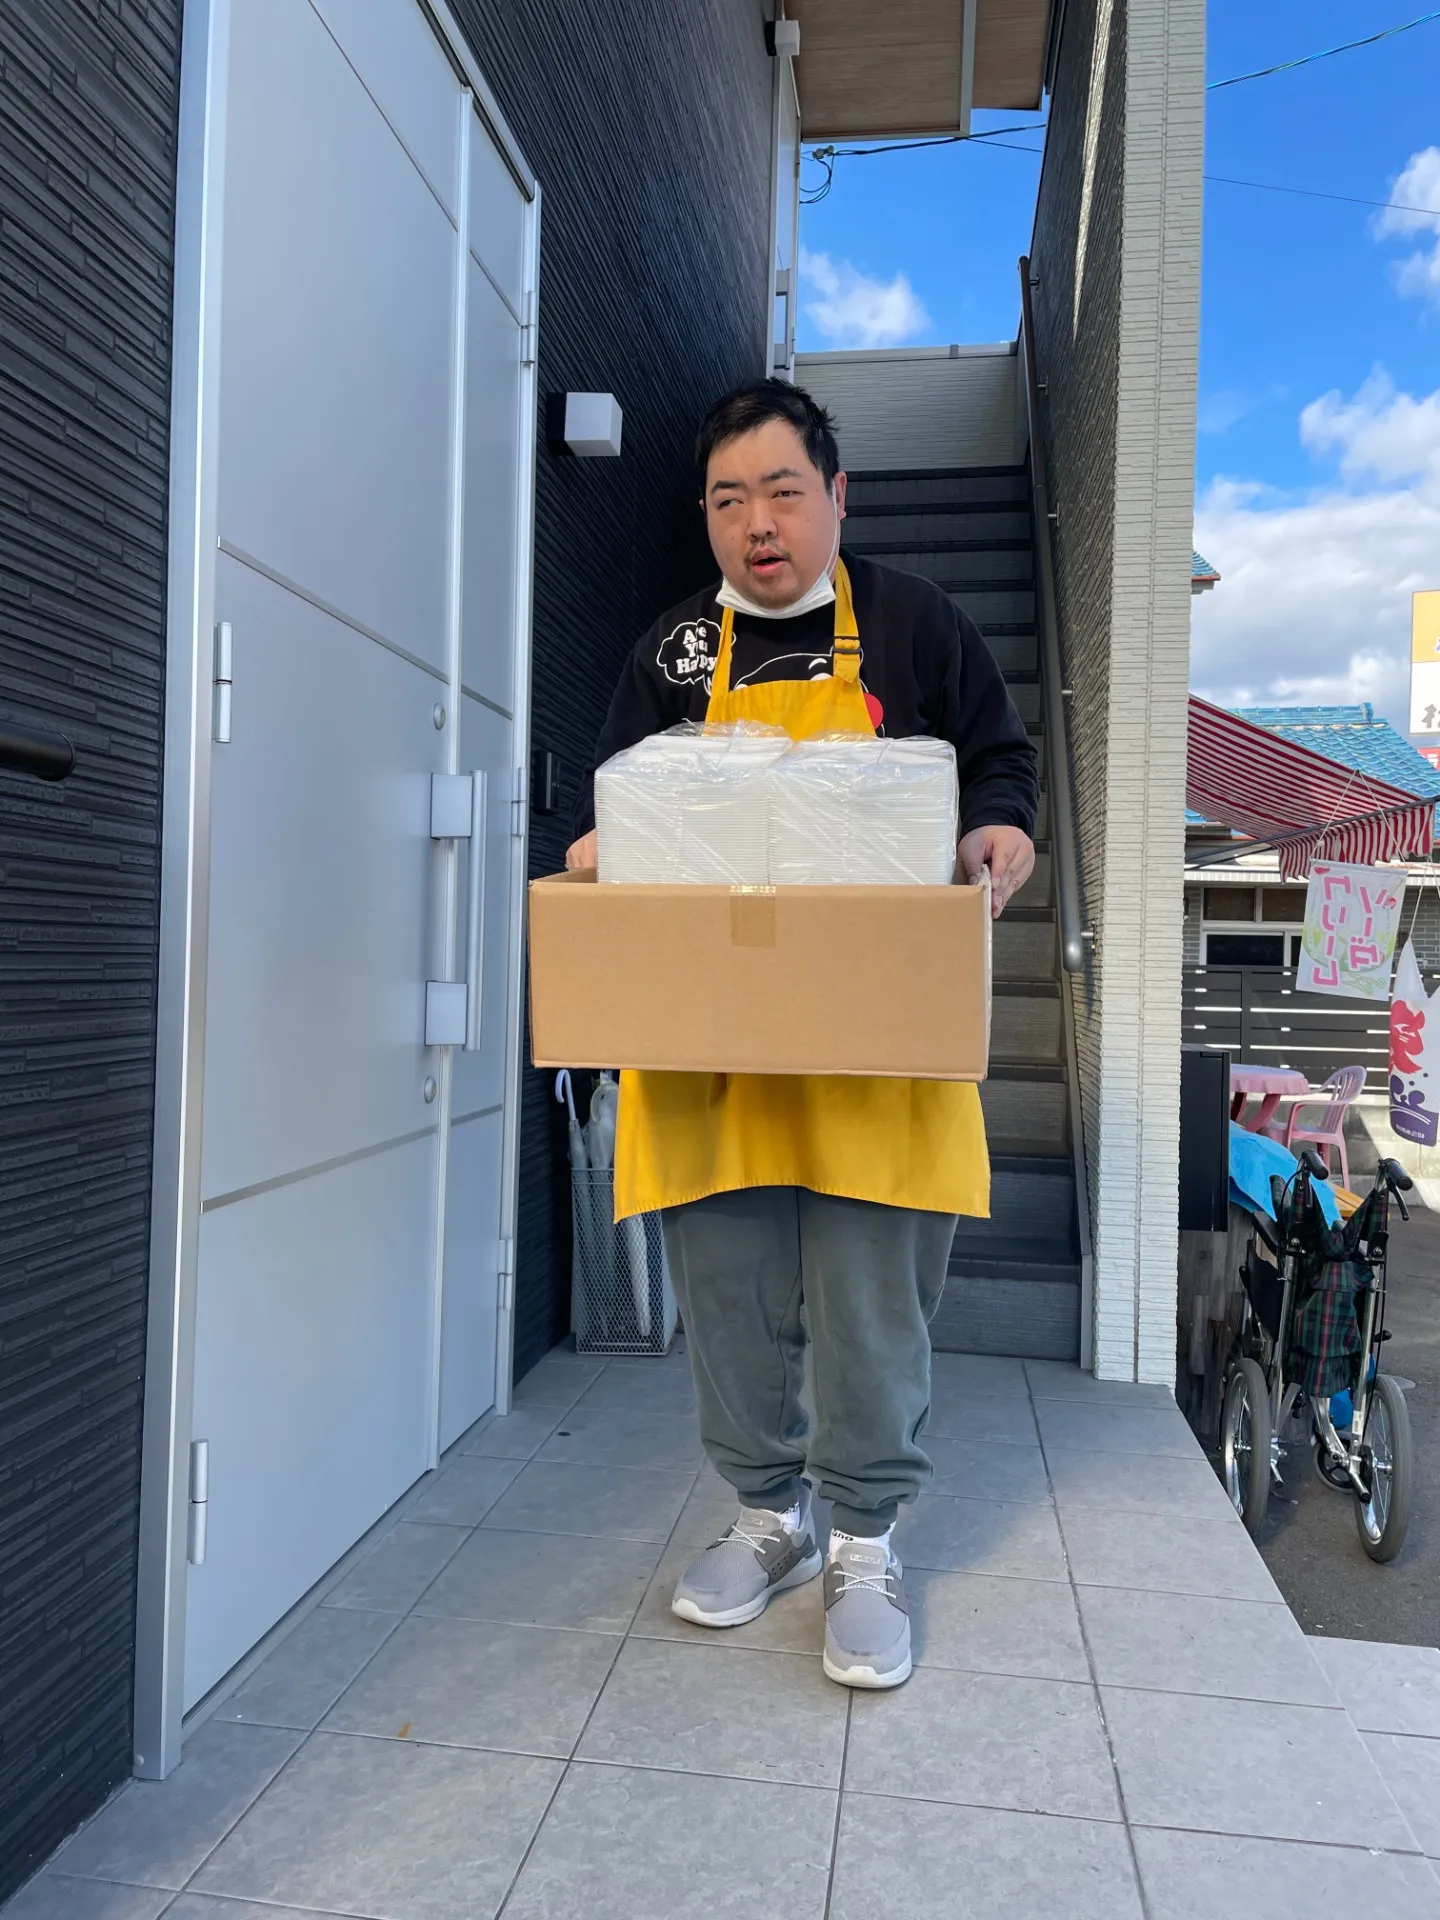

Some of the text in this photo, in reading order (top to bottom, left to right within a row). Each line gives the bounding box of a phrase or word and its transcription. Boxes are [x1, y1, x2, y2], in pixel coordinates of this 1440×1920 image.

[683, 626, 707, 645] Ae
[685, 640, 708, 657] Yu
[676, 654, 718, 674] Hapy
